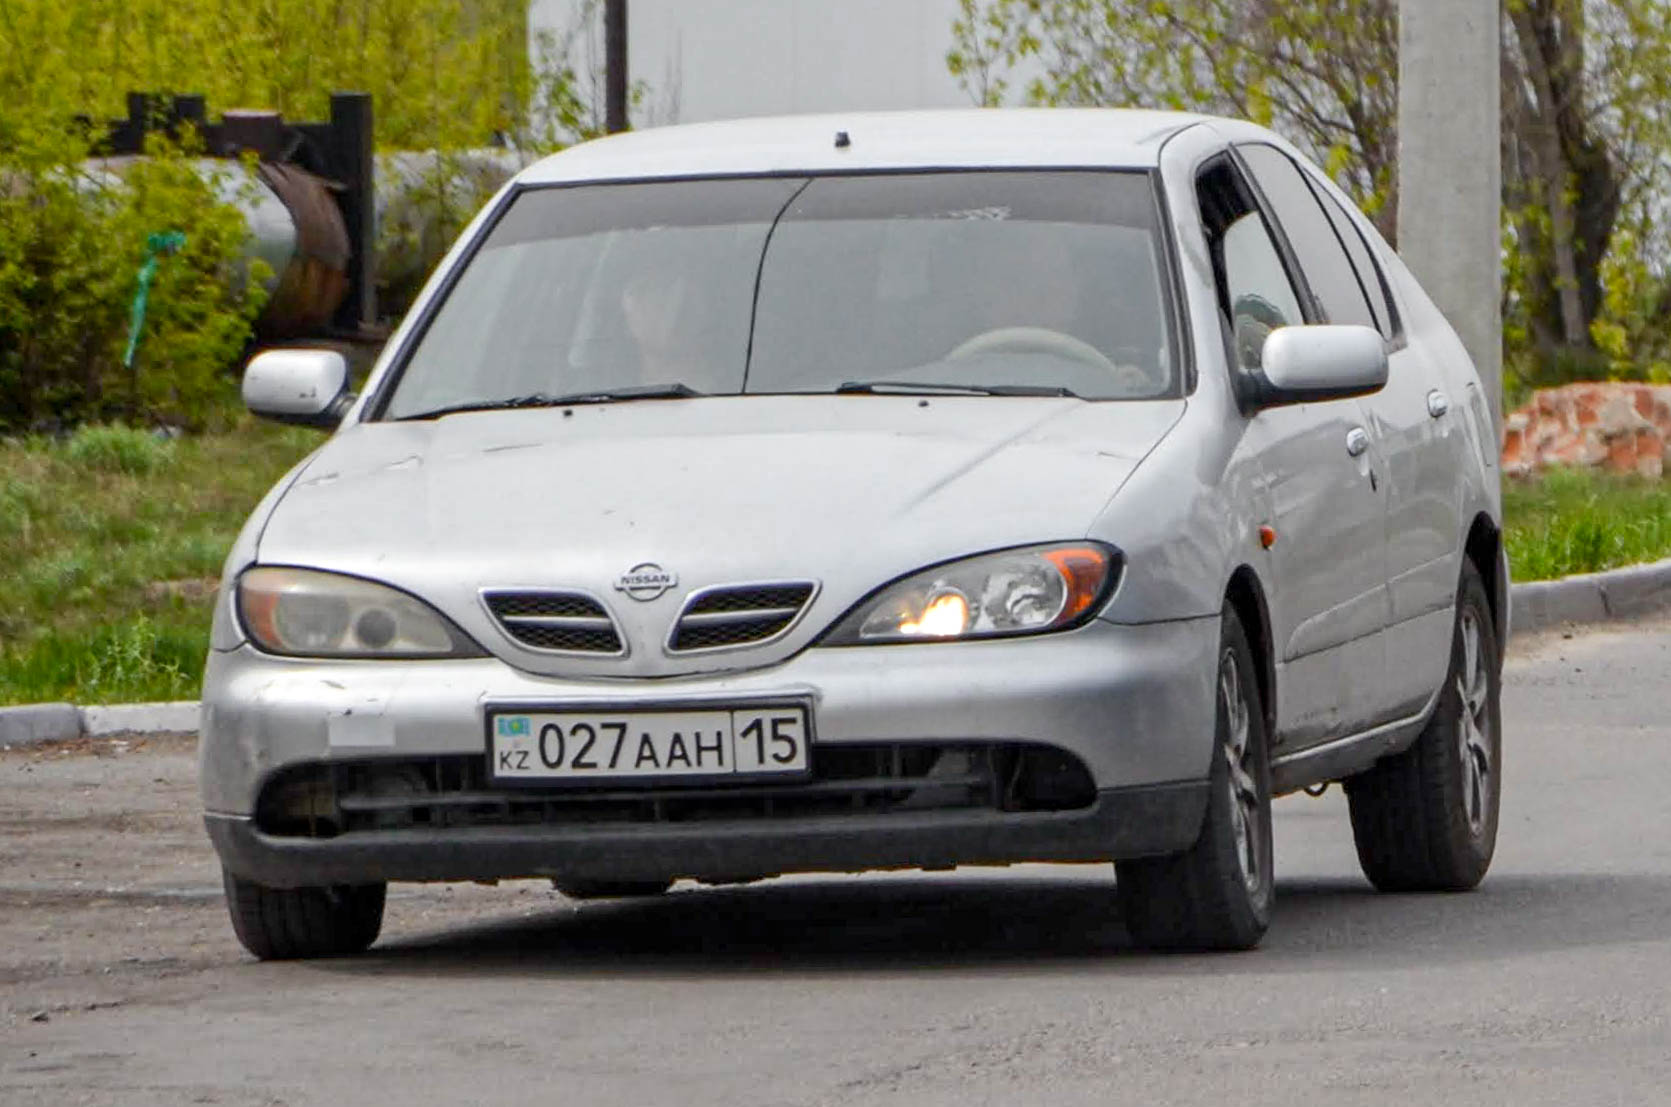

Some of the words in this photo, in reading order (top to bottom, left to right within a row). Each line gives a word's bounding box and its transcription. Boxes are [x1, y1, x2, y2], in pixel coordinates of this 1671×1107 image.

[621, 575, 670, 584] NISSAN
[499, 751, 531, 771] KZ
[739, 717, 798, 765] 15
